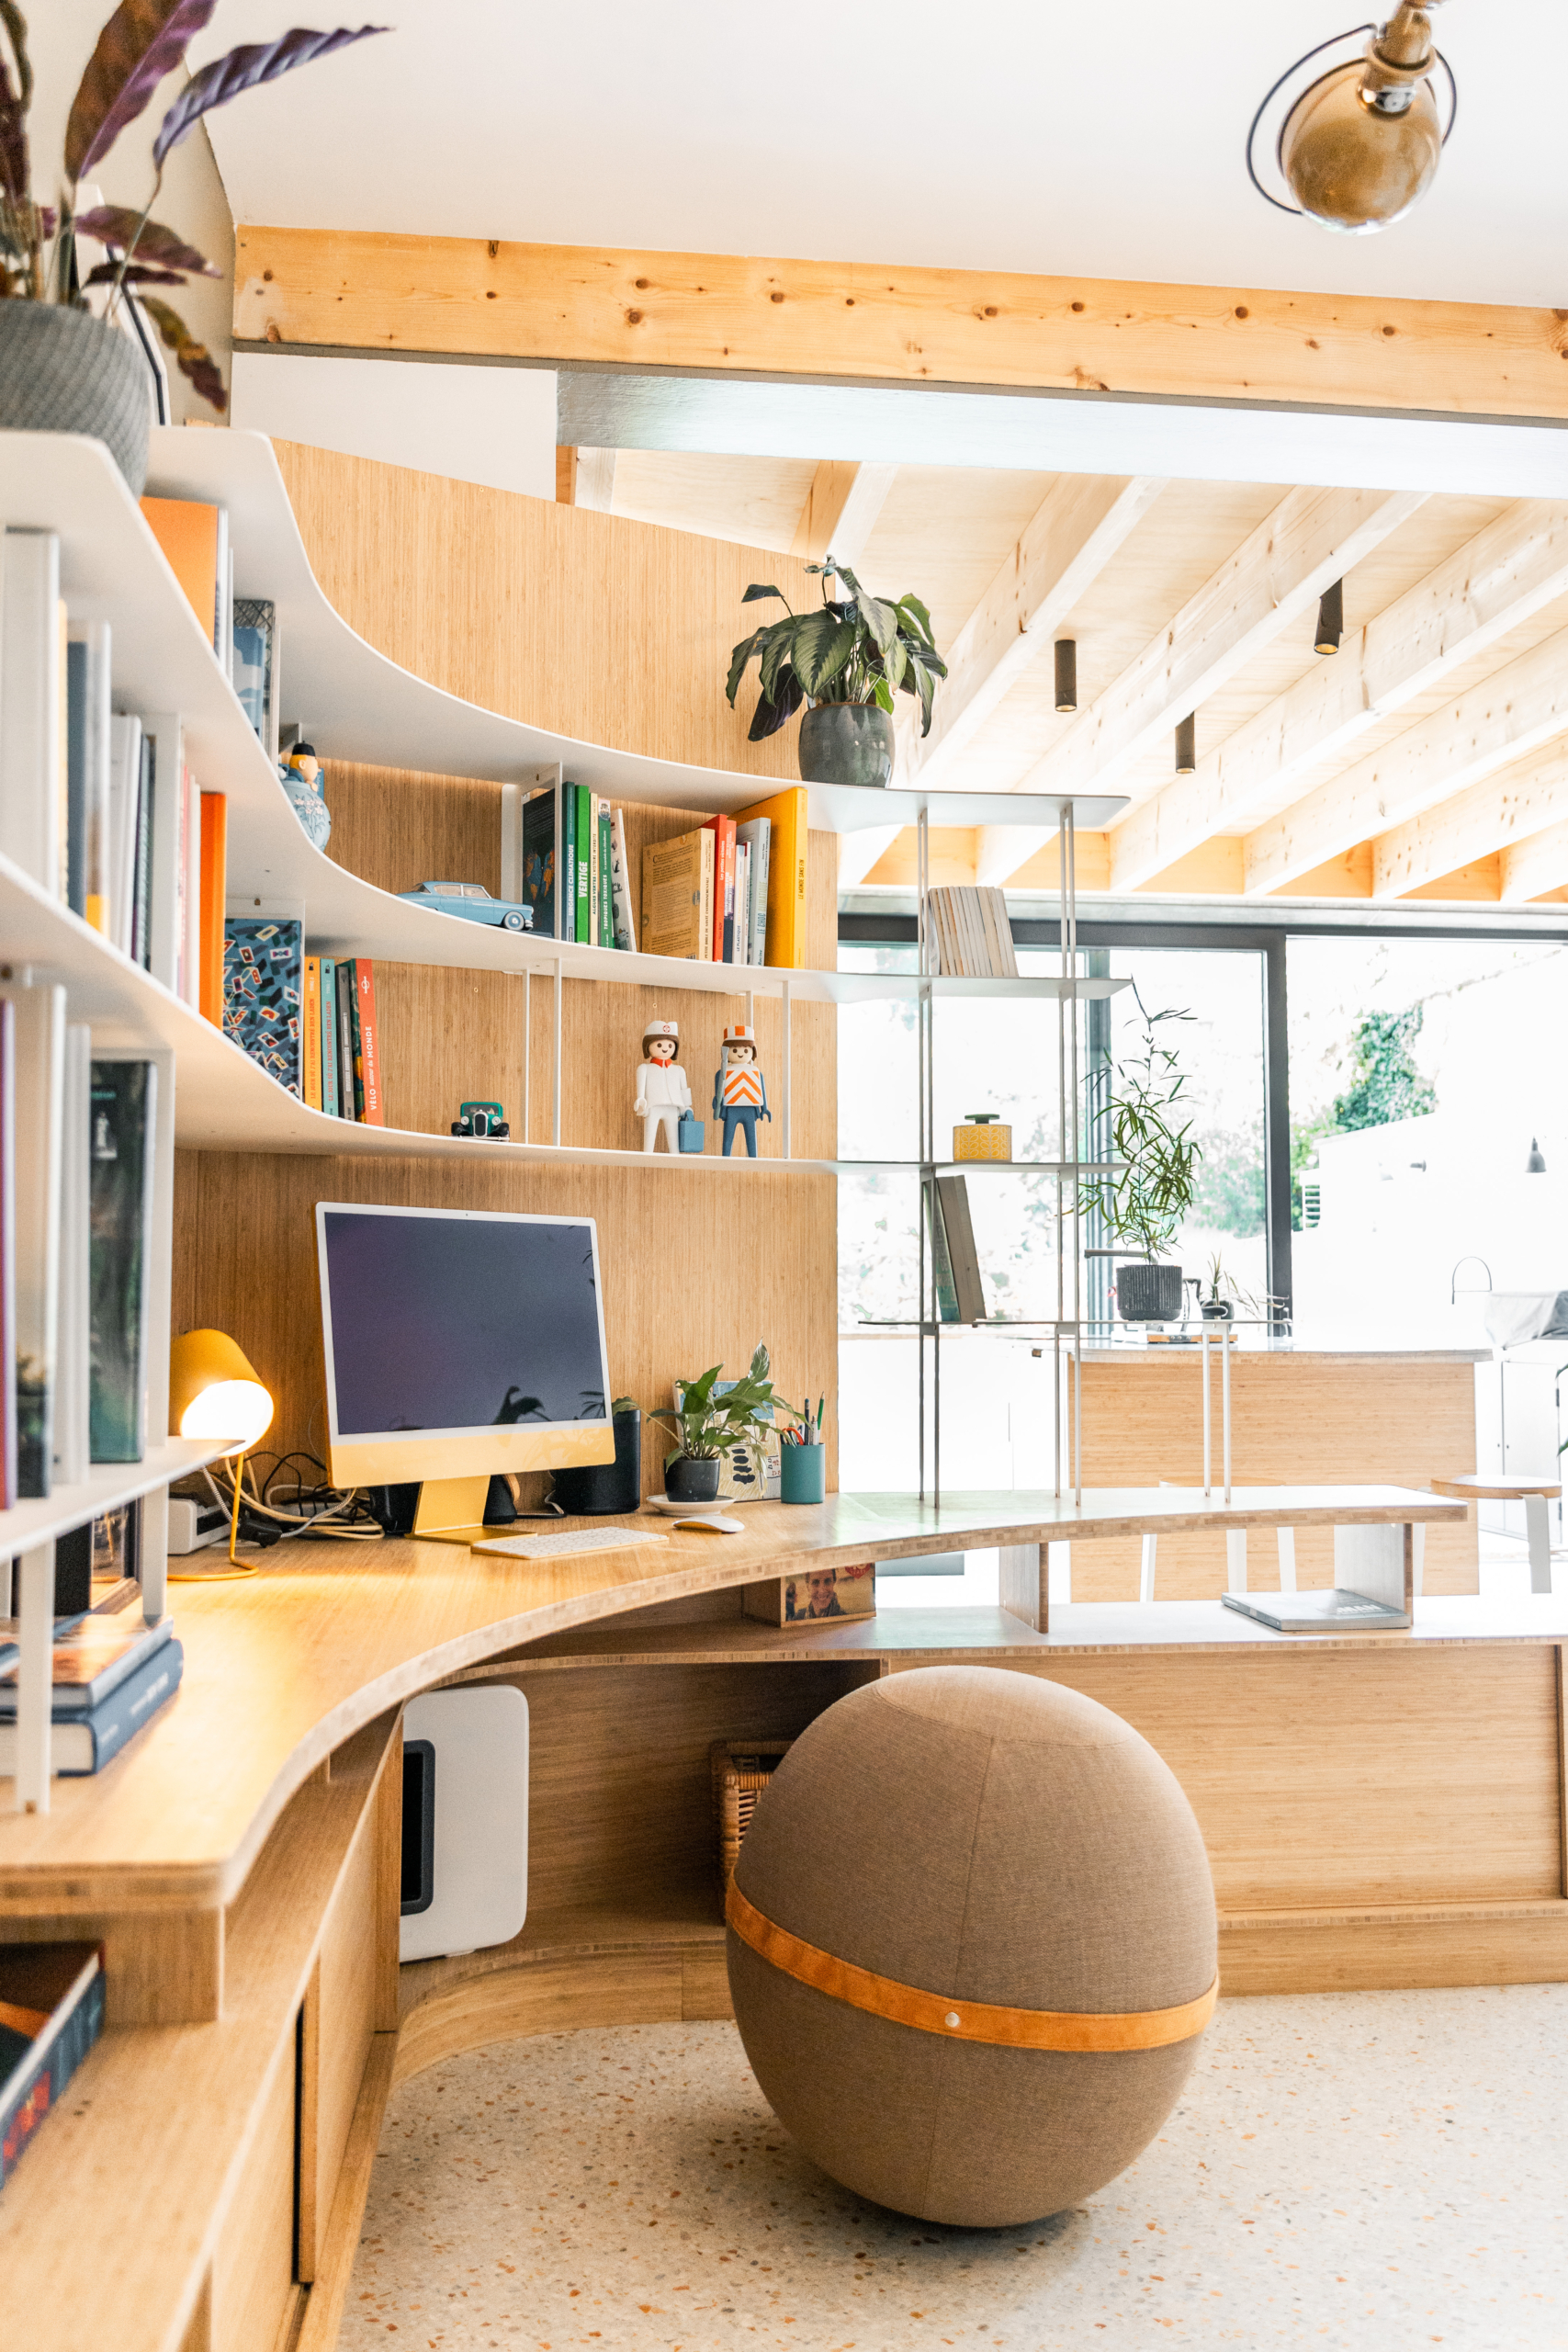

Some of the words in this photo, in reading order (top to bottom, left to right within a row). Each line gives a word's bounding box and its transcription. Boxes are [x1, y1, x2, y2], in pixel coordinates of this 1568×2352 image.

[579, 861, 588, 898] VERTIGE
[758, 881, 767, 912] CLIMATIQUE
[757, 913, 765, 927] CHOC
[365, 1026, 374, 1057] MONDE
